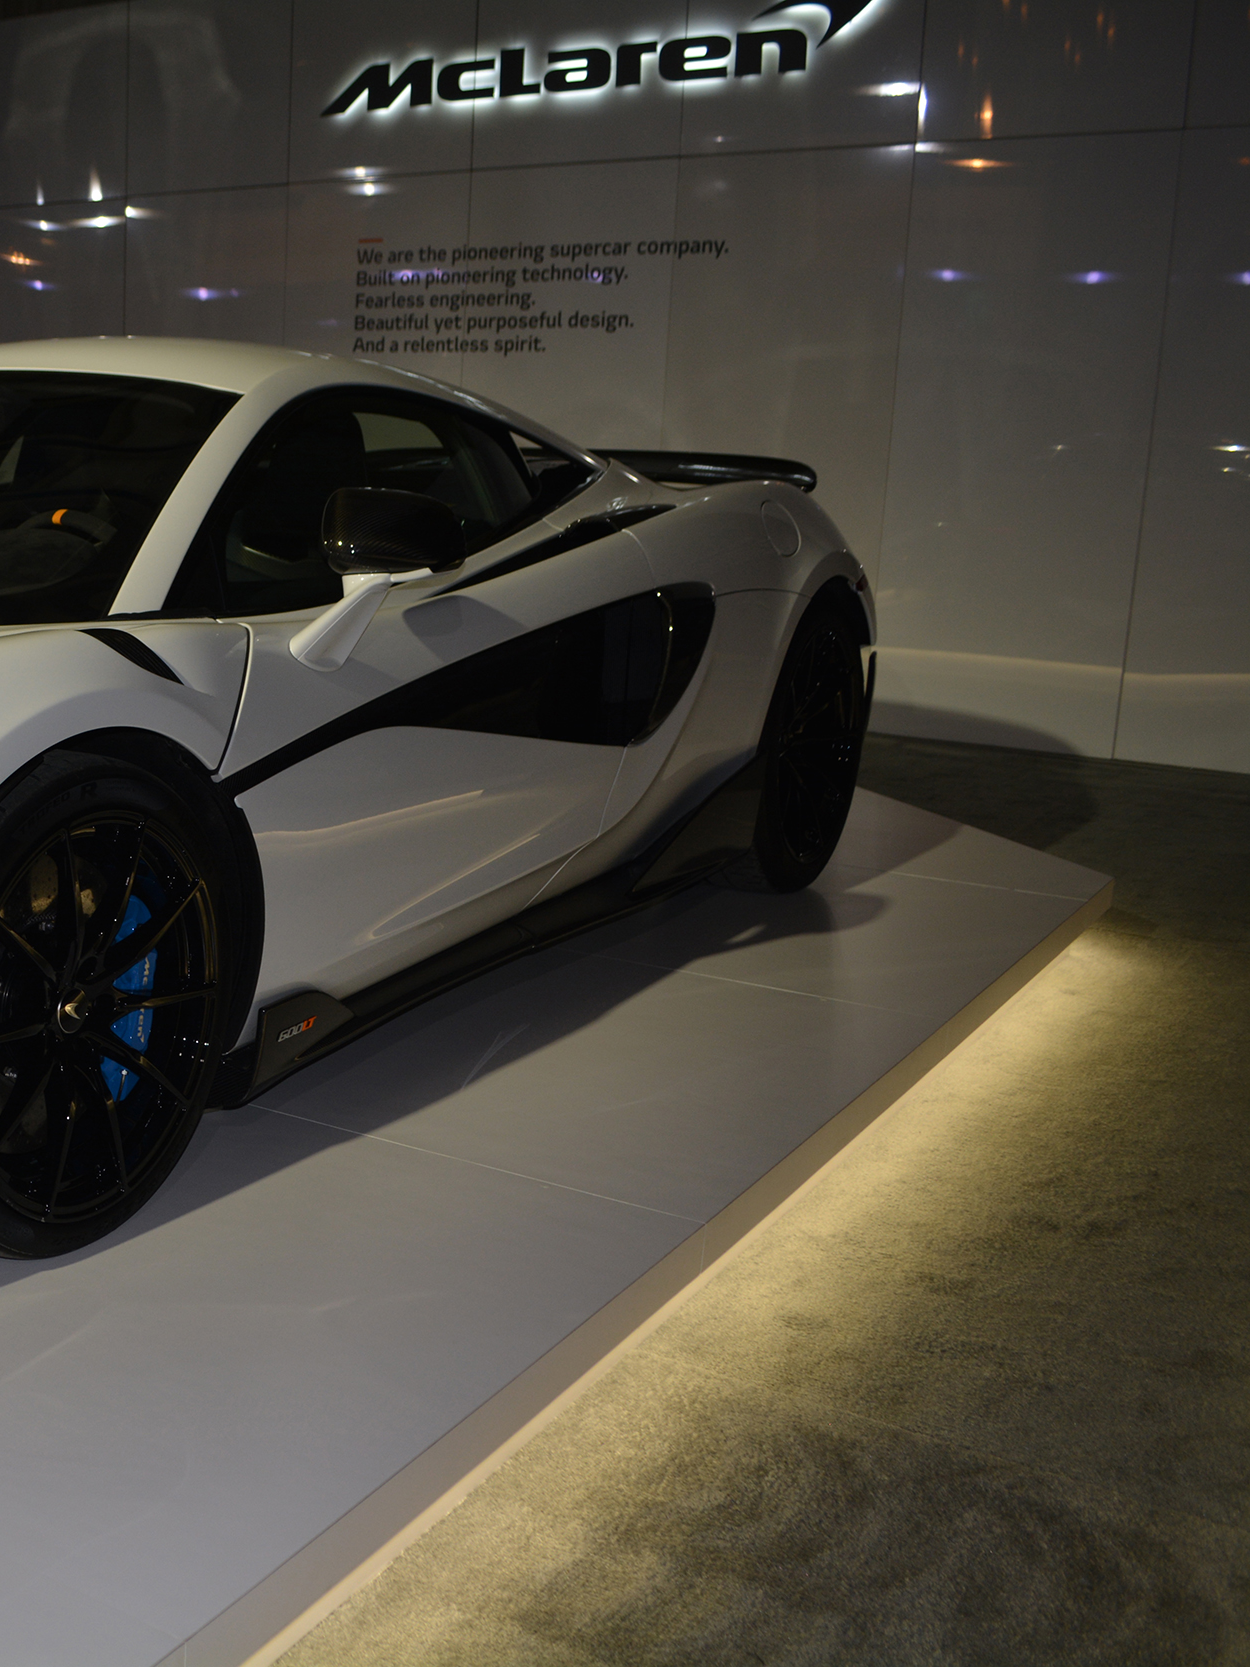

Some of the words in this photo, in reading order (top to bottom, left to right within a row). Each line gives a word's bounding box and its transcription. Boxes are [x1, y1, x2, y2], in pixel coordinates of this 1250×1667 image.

[320, 28, 808, 117] McLaren
[357, 248, 383, 265] We
[388, 248, 414, 264] are
[419, 245, 447, 262] the
[452, 242, 545, 267] pioneering
[550, 241, 630, 262] supercar
[637, 239, 729, 260] company.
[356, 270, 395, 287] Built
[400, 273, 420, 284] on
[425, 266, 516, 290] pioneering
[522, 264, 628, 286] technology.
[355, 292, 424, 309] Fearless
[429, 289, 535, 311] engineering.
[354, 313, 429, 331] Beautiful
[434, 314, 462, 334] yet
[467, 310, 562, 334] purposeful
[568, 310, 634, 333] design.
[353, 336, 385, 352] And
[389, 342, 398, 352] a
[403, 335, 488, 352] relentless
[494, 334, 546, 357] spirit.
[277, 1015, 317, 1042] 600LT
